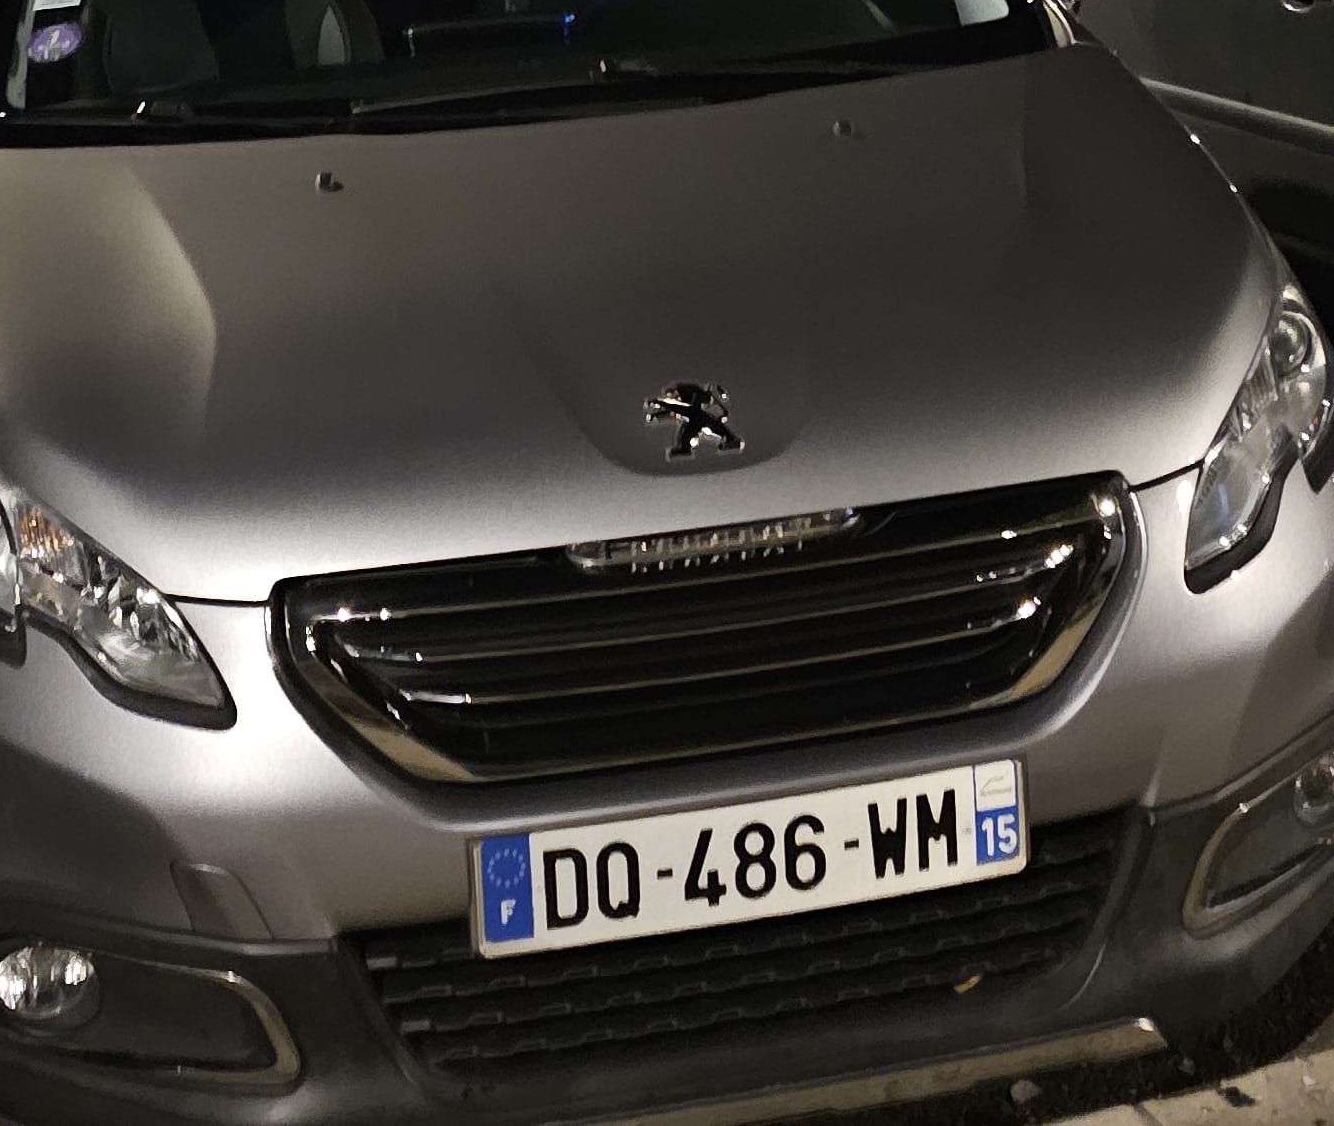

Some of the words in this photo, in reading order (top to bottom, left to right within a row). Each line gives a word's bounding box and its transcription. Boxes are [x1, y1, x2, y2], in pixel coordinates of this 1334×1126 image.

[499, 897, 516, 925] F
[543, 788, 959, 931] DQ-486-WM
[981, 814, 1017, 856] 15
